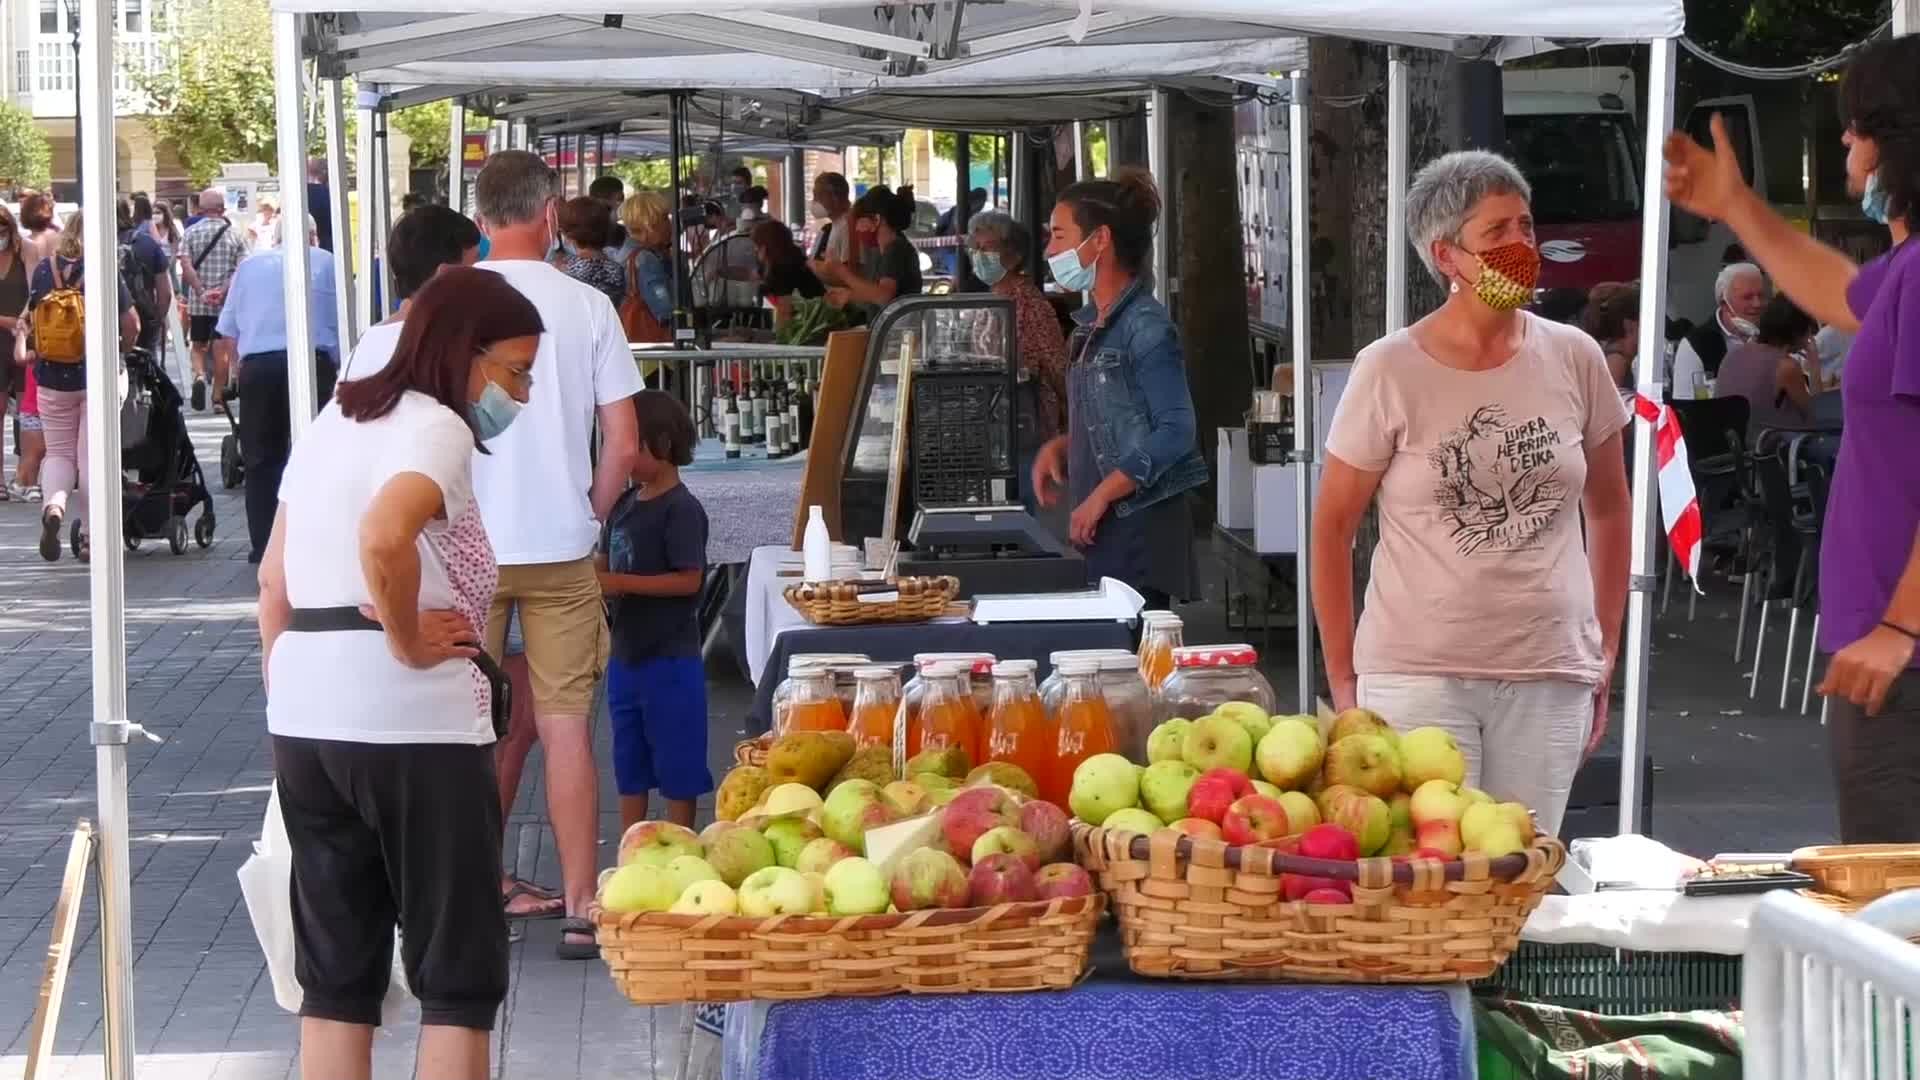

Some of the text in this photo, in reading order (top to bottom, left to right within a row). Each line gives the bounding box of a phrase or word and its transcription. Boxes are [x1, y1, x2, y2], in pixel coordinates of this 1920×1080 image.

[1505, 416, 1549, 444] LURRA
[1497, 431, 1560, 459] HERRIARI
[1510, 449, 1555, 473] DEIKA
